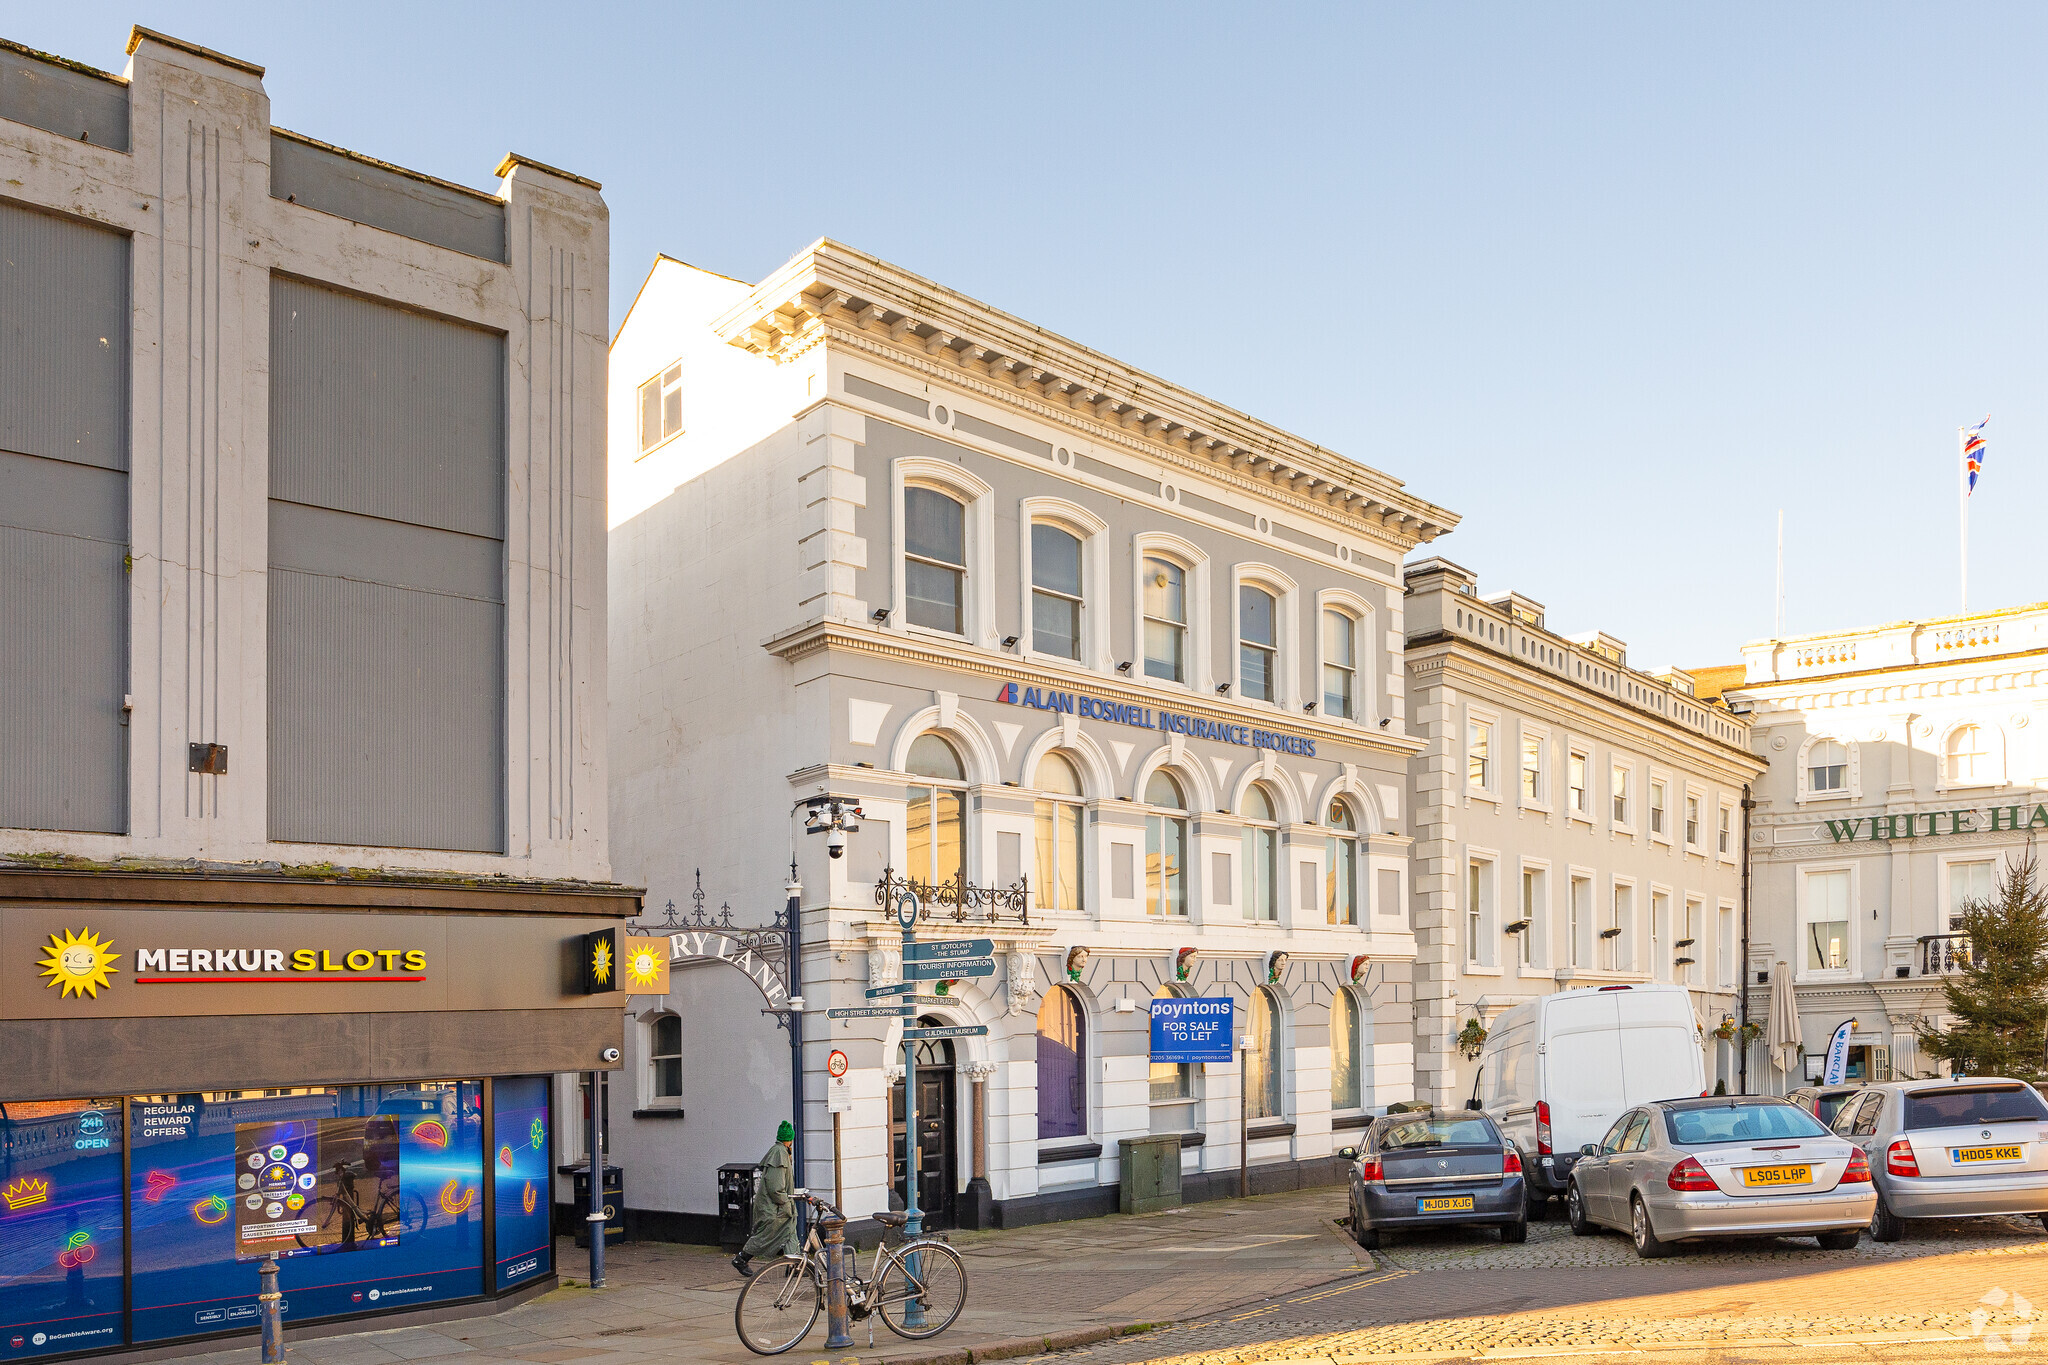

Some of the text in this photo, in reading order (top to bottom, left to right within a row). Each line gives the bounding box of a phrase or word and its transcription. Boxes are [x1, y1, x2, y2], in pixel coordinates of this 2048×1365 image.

[1023, 686, 1074, 714] ALAN
[1080, 695, 1155, 729] BOSWELL
[1160, 711, 1250, 746] INSURANCE
[1253, 729, 1317, 758] BROKERS
[1824, 809, 1978, 844] WHITE
[941, 942, 973, 950] BOTOLPH'S
[137, 948, 427, 972] MERKUR SLOTS
[918, 960, 992, 970] TOURIST INFORMATION
[669, 931, 788, 1008] RY LANE
[940, 969, 969, 977] CENTRE
[882, 987, 895, 995] STATION
[921, 997, 939, 1005] MARKET
[871, 1008, 900, 1016] SHOPPING
[1151, 1001, 1230, 1019] poyntons
[955, 1027, 979, 1035] MUSEUM
[1162, 1021, 1219, 1031] FOR SALE
[1171, 1031, 1212, 1041] TO LET
[144, 1105, 195, 1116] REGULAR
[81, 1117, 104, 1128] 24h
[144, 1116, 191, 1126] REWARD
[143, 1127, 186, 1137] OFFERS
[75, 1138, 109, 1150] OPEN
[1961, 1147, 2020, 1160] HD05 KKE
[895, 1163, 902, 1173] 7
[1749, 1168, 1806, 1183] LS05 LHP
[1424, 1199, 1471, 1209] MJ08 XJG
[243, 1220, 307, 1231] SUPPORTING COMMUNITY
[381, 1285, 433, 1297] BeGambleAware.org
[200, 1313, 222, 1321] SENSIBLY
[230, 1309, 256, 1317] ENJOYABLY
[49, 1327, 114, 1340] BeGambleAware.org
